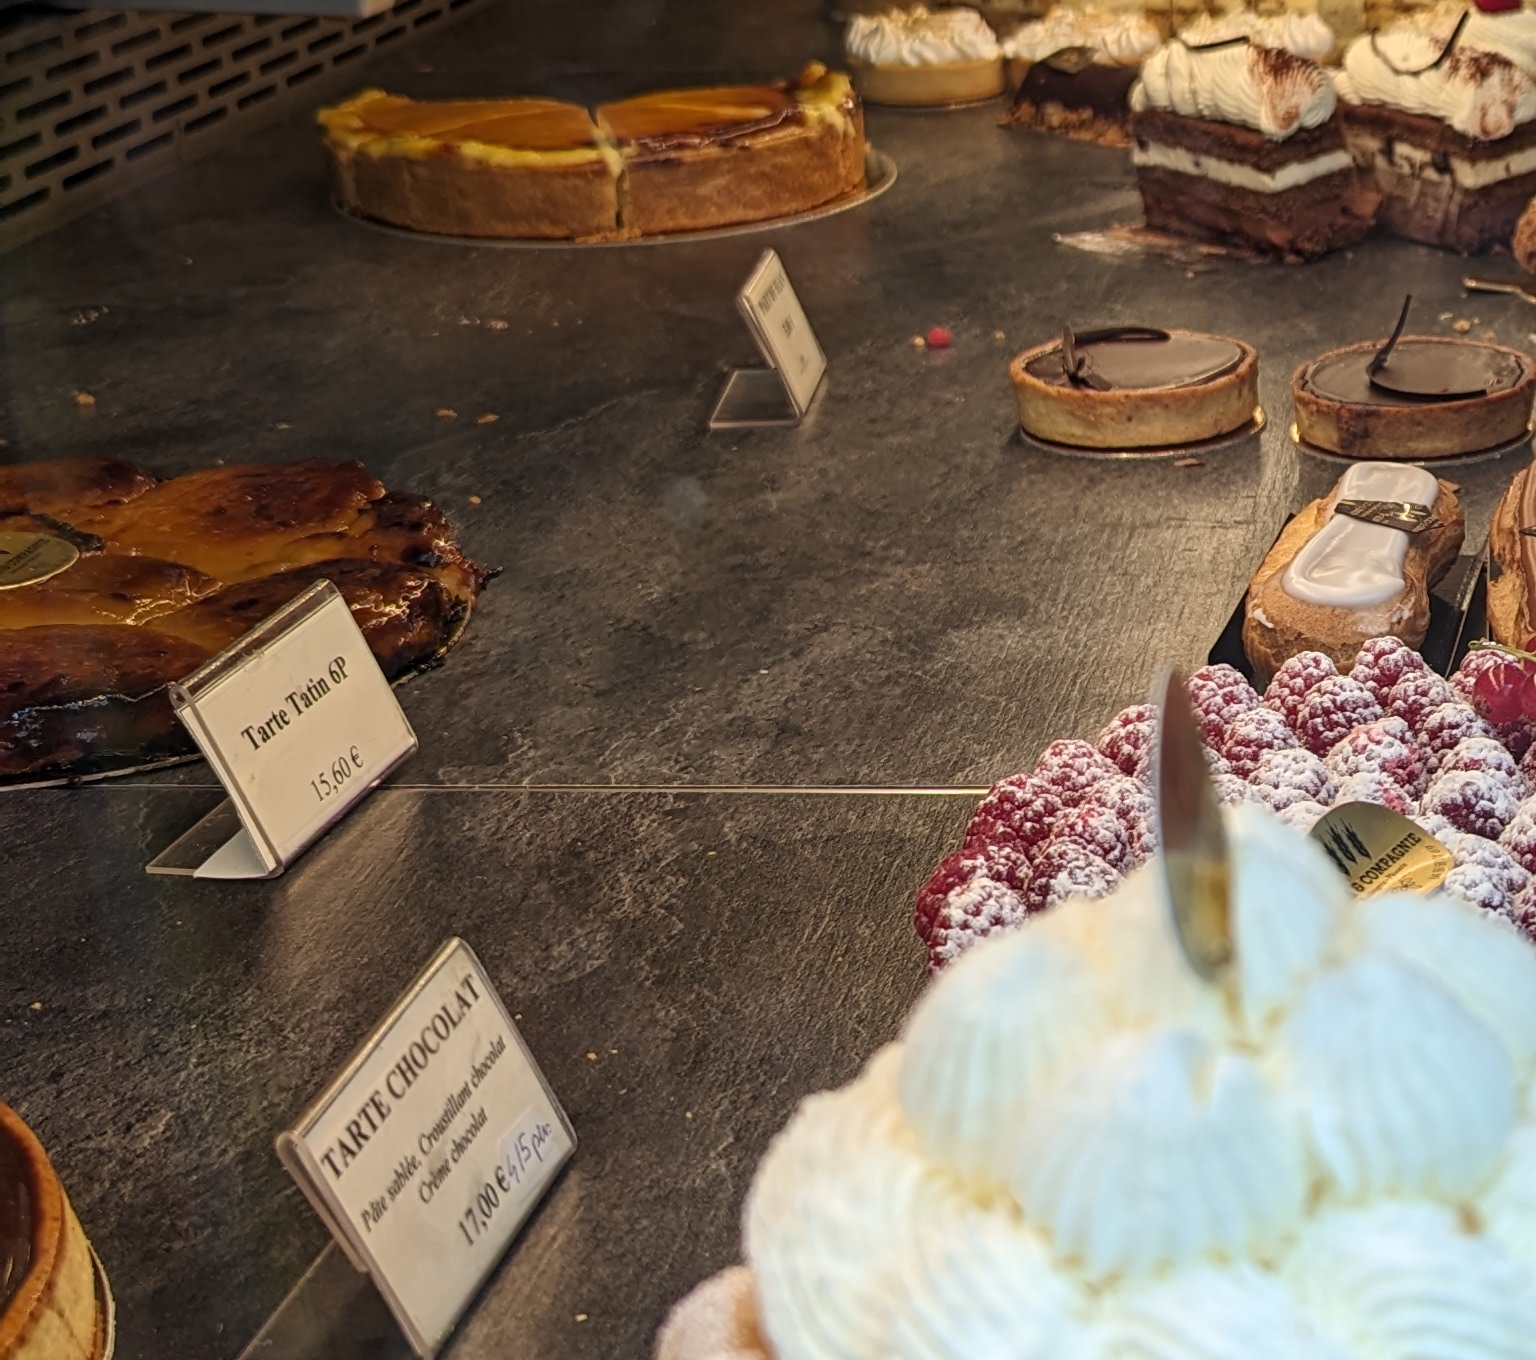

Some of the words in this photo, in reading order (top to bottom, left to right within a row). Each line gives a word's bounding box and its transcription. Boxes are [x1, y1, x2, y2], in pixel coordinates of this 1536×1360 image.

[240, 710, 291, 751] Tarte
[284, 678, 331, 717] Tatin
[329, 655, 349, 686] 6P
[310, 756, 351, 803] 15,60
[350, 745, 365, 769] €
[1360, 832, 1423, 885] COMPAGNIE
[319, 1089, 391, 1181] TARTE
[385, 973, 482, 1099] CHOCOLAT
[361, 1195, 388, 1234] Pâte
[418, 1087, 471, 1156] Croustillant
[470, 1034, 507, 1088] chocolat
[418, 1155, 453, 1205] Crème
[451, 1106, 488, 1165] chocolat
[456, 1188, 500, 1247] 17,00
[496, 1165, 512, 1195] €
